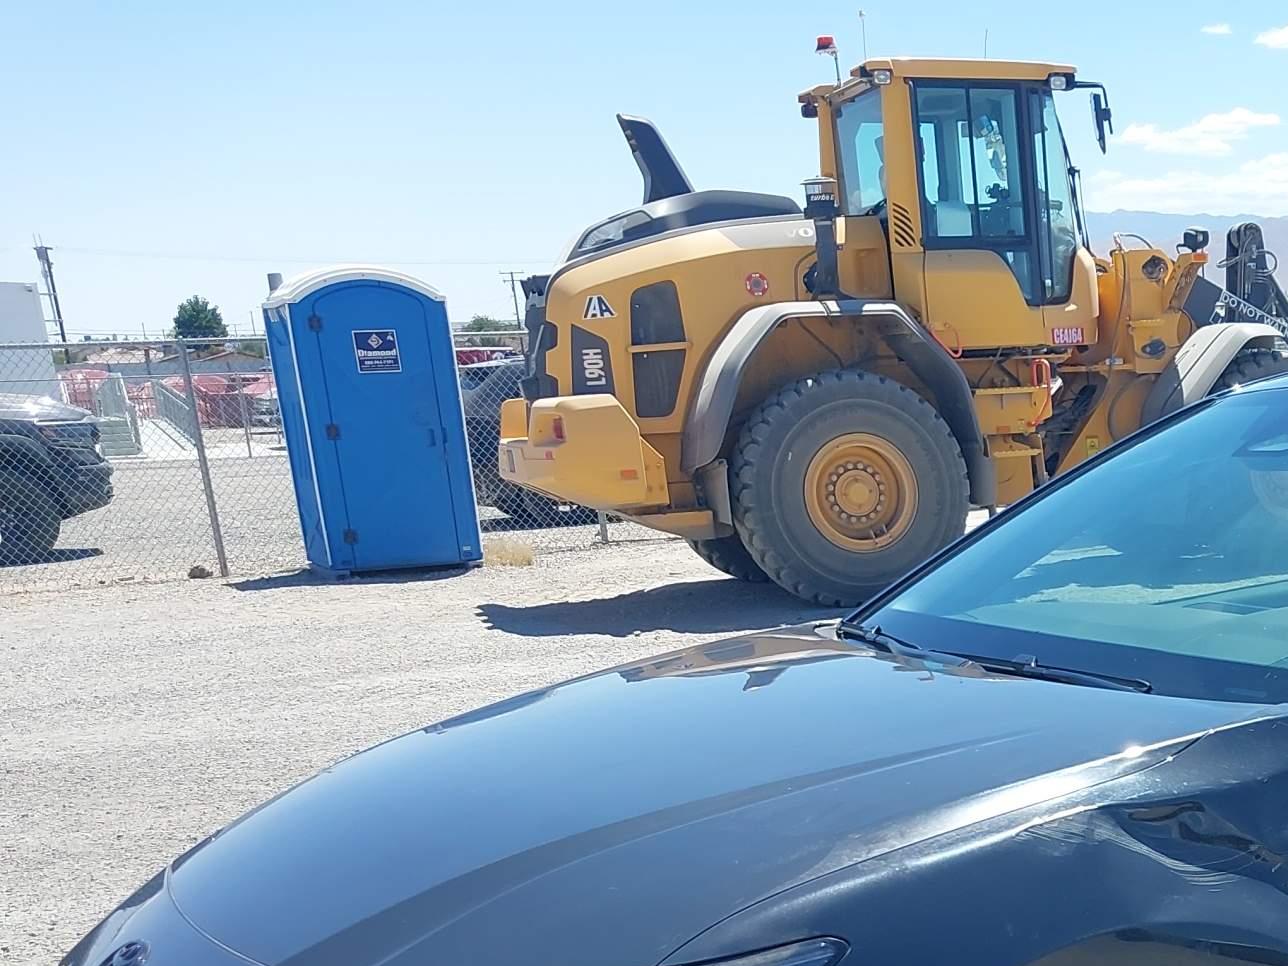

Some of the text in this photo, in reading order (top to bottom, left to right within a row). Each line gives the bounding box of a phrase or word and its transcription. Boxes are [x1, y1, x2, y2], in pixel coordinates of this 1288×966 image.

[1222, 293, 1238, 307] DO
[1238, 303, 1261, 321] NOT
[357, 348, 397, 357] Diamond
[582, 348, 607, 386] L90H
